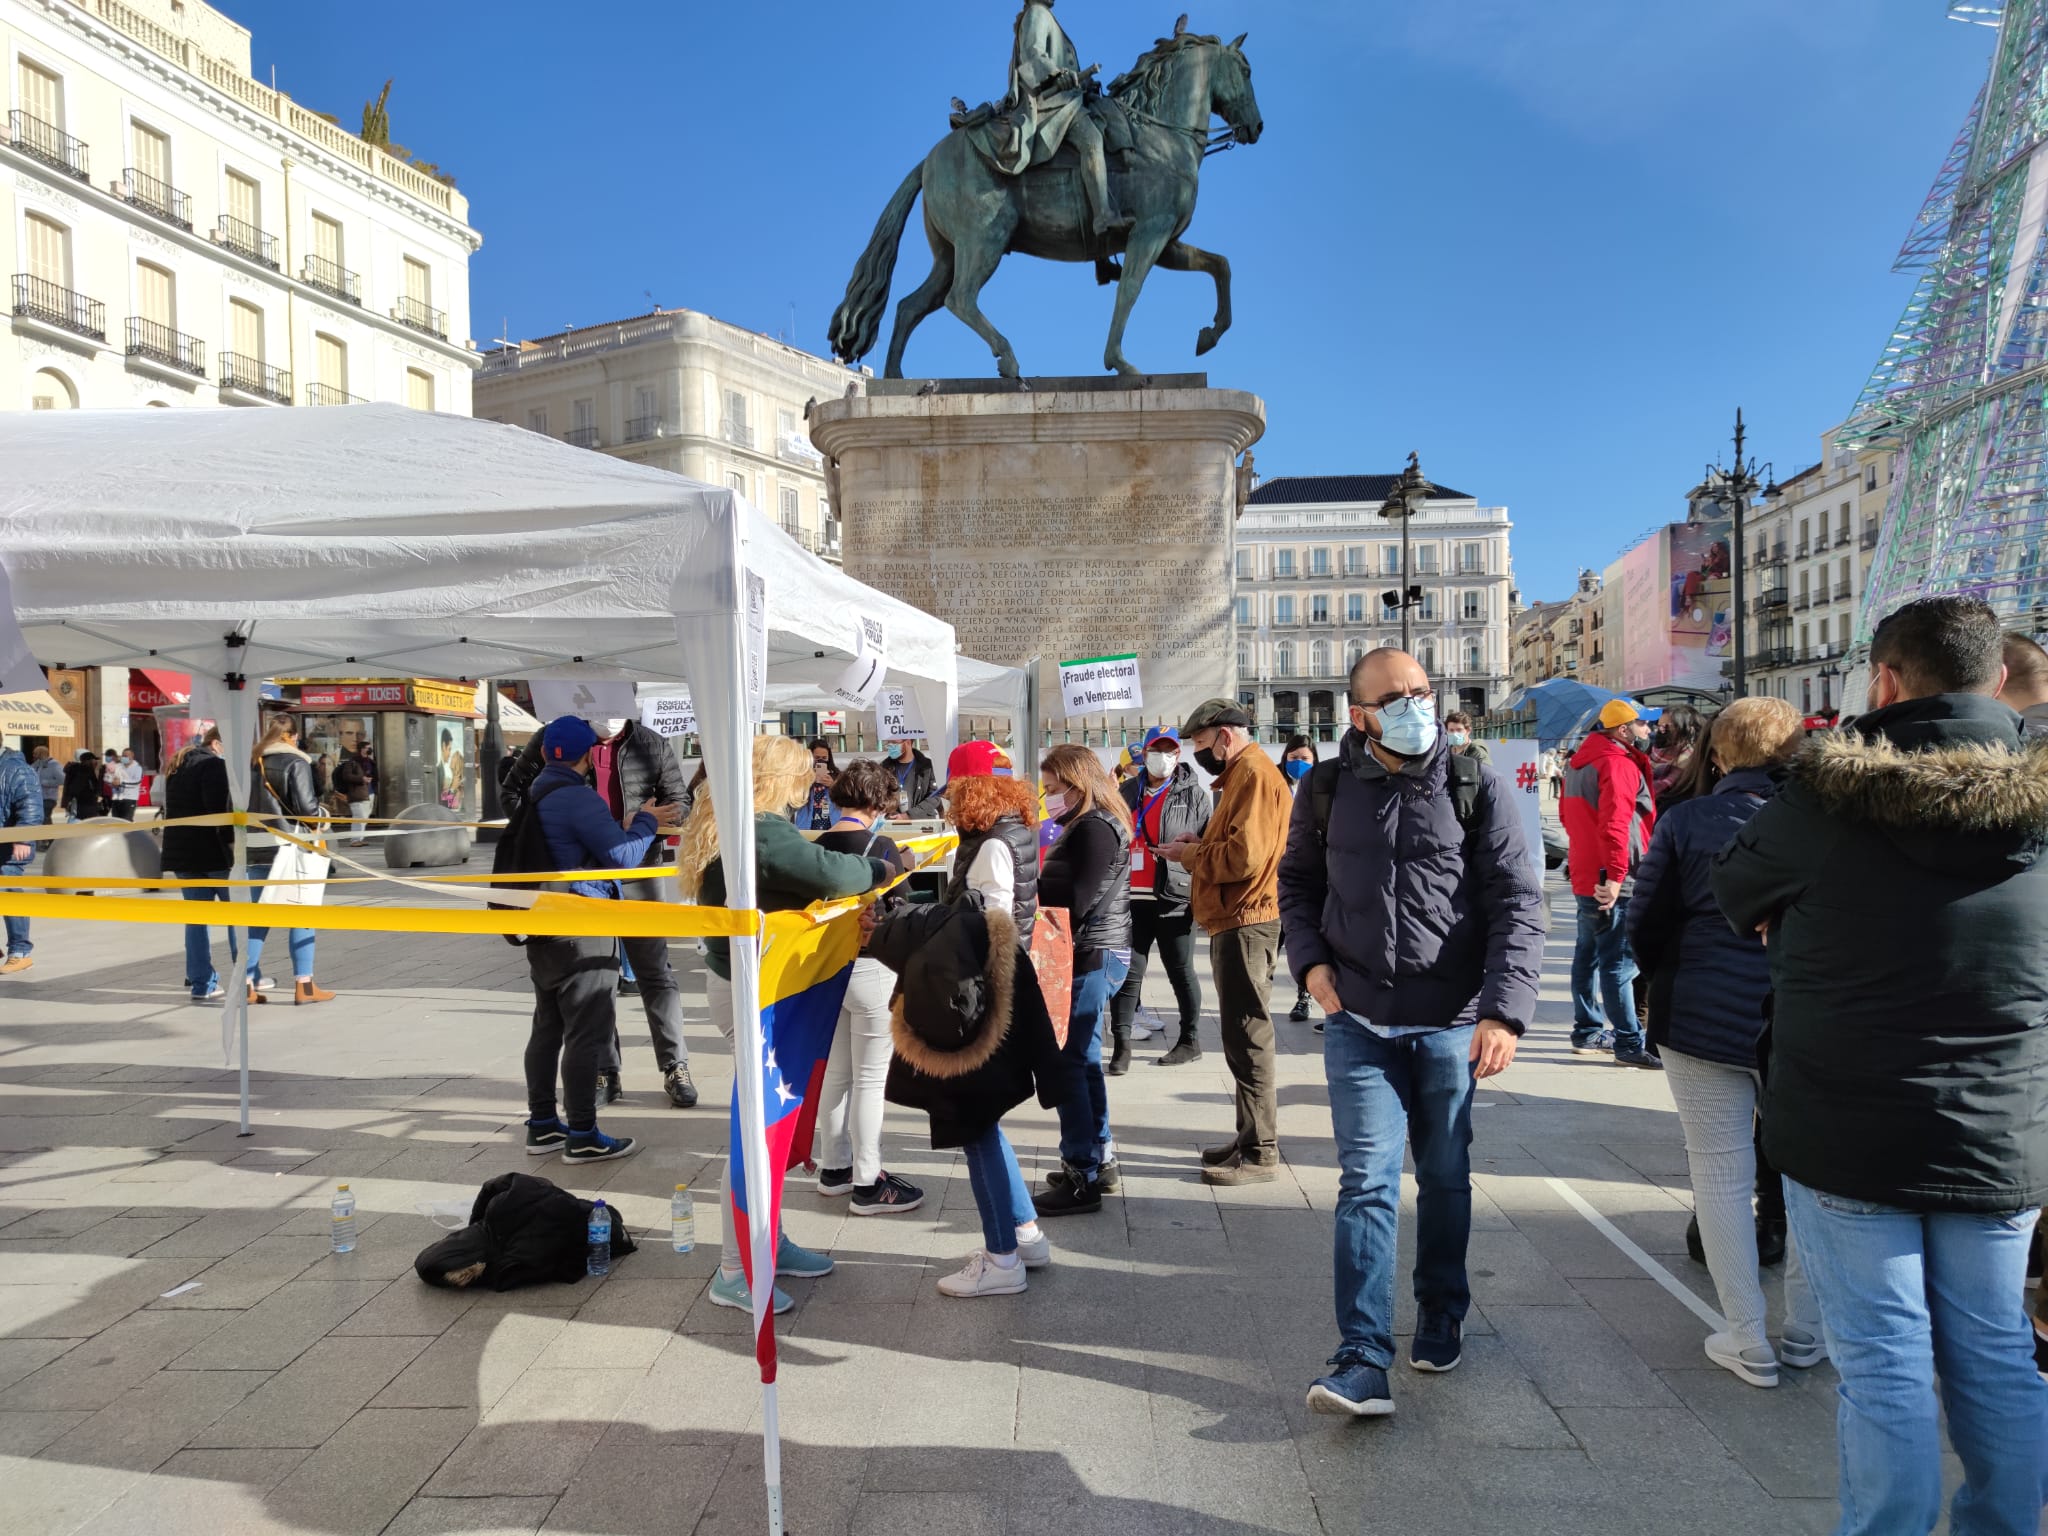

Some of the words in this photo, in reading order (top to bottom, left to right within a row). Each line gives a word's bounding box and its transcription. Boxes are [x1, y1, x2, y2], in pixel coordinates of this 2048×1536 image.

[989, 562, 1028, 570] TOSCANA
[1045, 562, 1060, 570] REY
[878, 571, 925, 580] NOTABLES
[949, 580, 961, 588] DE
[970, 580, 982, 588] LA
[992, 580, 1047, 588] SOCIEDAD
[1071, 579, 1080, 587] EL
[1086, 579, 1130, 587] FOMENTO
[1137, 579, 1148, 587] DE
[944, 589, 954, 597] DE
[960, 589, 976, 597] LAS
[982, 589, 1034, 597] SOCIEDADES
[1041, 588, 1098, 596] ECONOMICAS
[1105, 588, 1115, 596] DE
[1121, 587, 1158, 595] AMIGOS
[1164, 587, 1179, 595] DEL
[960, 599, 970, 607] EL
[978, 598, 1044, 606] DESARROLLO
[1051, 598, 1063, 606] DE
[1092, 597, 1143, 605] ACTIVIDAD
[991, 607, 1000, 615] DE
[1008, 607, 1049, 615] CANALES
[1067, 606, 1108, 614] CAMINOS
[1034, 616, 1062, 624] VNICA
[995, 625, 1041, 633] PROMOVIO
[1048, 625, 1062, 633] LAS
[1058, 634, 1074, 642] LAS
[1082, 634, 1145, 642] POBLACIONES
[972, 644, 1026, 653] HIGIENICAS
[1046, 644, 1056, 652] DE
[1064, 643, 1108, 651] LIMPIEZA
[1115, 643, 1125, 651] DE
[1133, 642, 1149, 650] LAS
[1063, 668, 1095, 688] ¡Fraude
[1097, 664, 1135, 679] electoral
[368, 687, 401, 701] TICKETS
[1073, 695, 1084, 706] en
[1085, 687, 1132, 703] Venezuela!
[416, 690, 434, 705] TOURS
[441, 694, 463, 708] TICKETS
[653, 717, 696, 726] INCIDEN
[8, 722, 40, 731] CHANGE
[660, 725, 687, 734] CIAS
